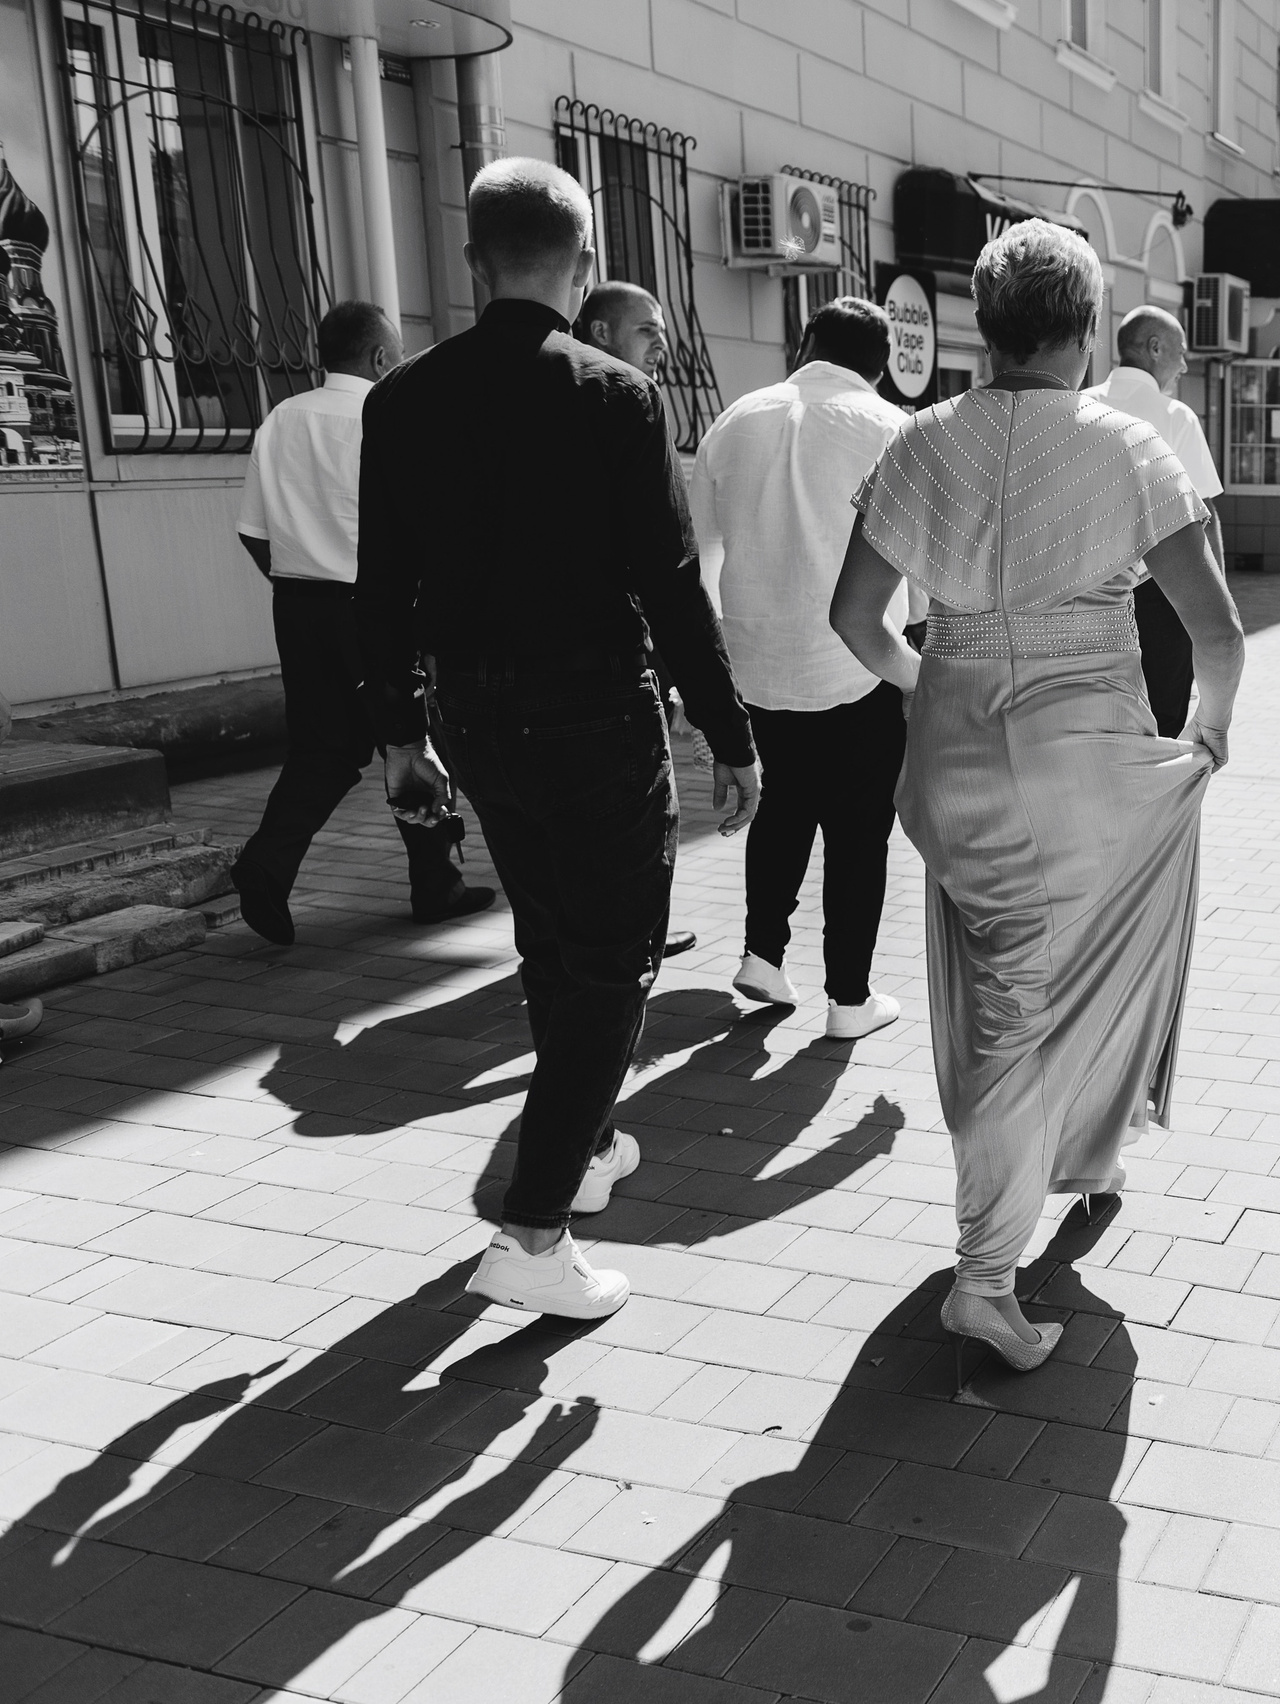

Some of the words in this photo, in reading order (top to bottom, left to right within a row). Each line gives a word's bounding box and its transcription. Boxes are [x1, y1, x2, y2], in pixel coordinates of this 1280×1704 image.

[888, 300, 929, 327] Bubble
[894, 326, 924, 353] Vape
[897, 352, 923, 374] Club
